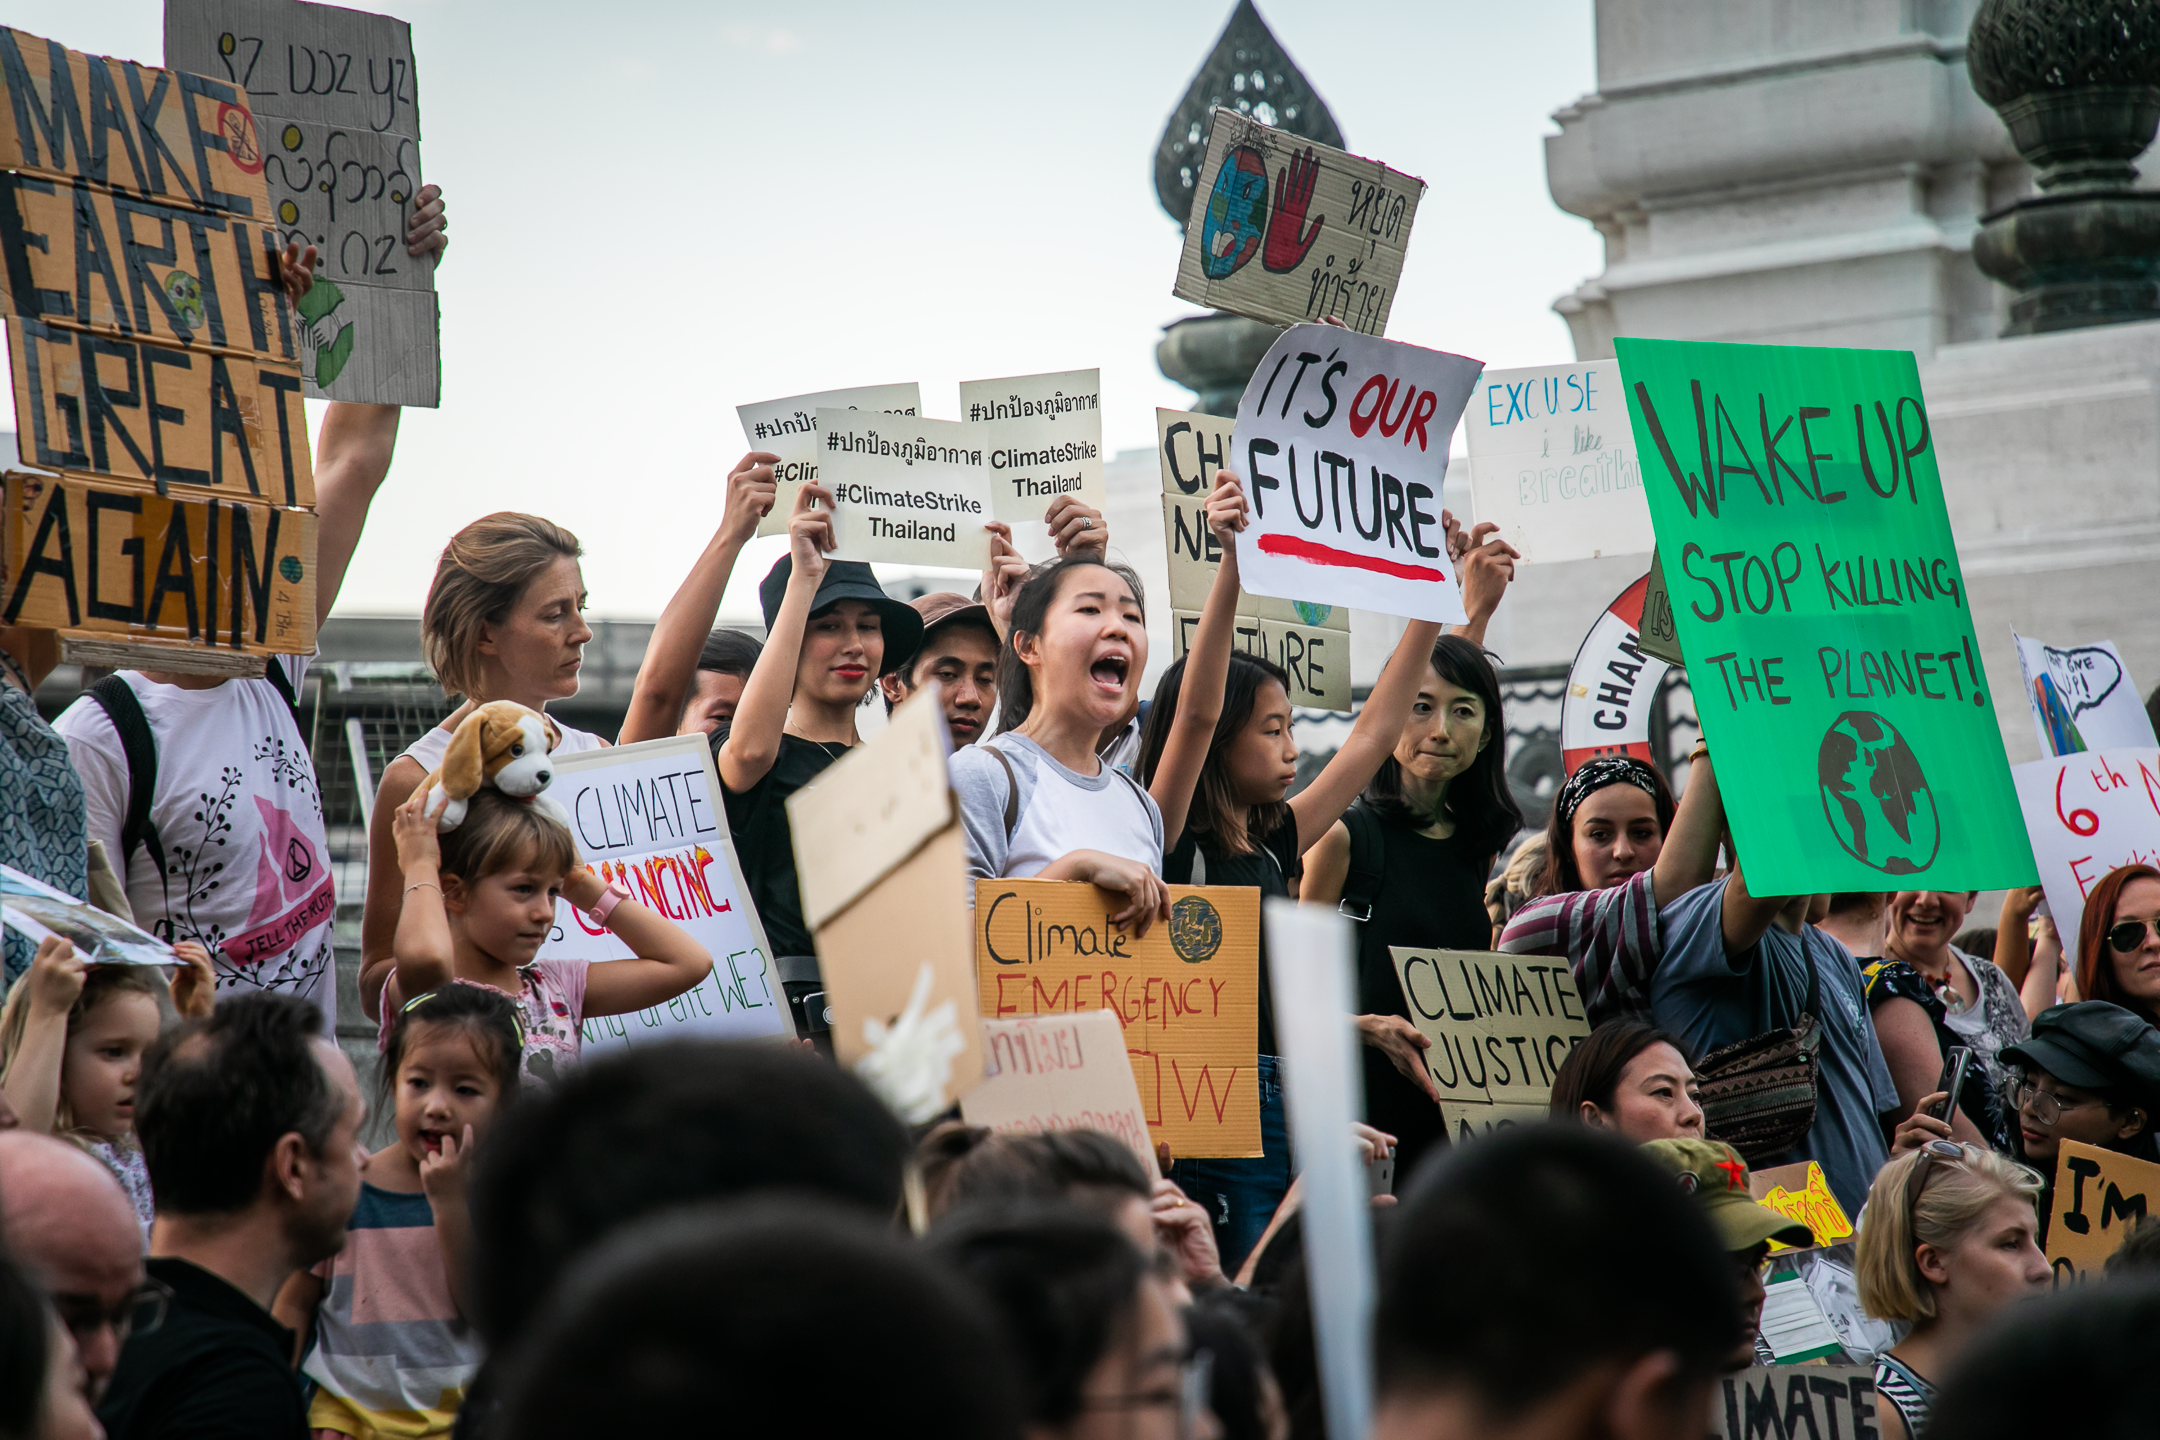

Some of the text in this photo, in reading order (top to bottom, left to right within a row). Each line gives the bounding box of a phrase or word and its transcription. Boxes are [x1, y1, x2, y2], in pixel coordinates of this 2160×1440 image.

[0, 27, 252, 216] MAKE
[0, 168, 299, 360] EARTH
[22, 316, 301, 507] GREAT
[970, 391, 1098, 422] #ปกป้องภูมิอากาศ
[1257, 347, 1438, 453] IT'S OUR
[1488, 372, 1598, 426] EXCUSE
[827, 430, 982, 466] #ปกป้องภูมิอากาศ
[989, 441, 1097, 470] ClimateStrike
[1165, 421, 1232, 495] CH
[1519, 449, 1643, 506] Breathi
[1634, 379, 1929, 518] WAKE UP
[836, 483, 982, 514] #ClimateStrike
[1012, 472, 1082, 498] Thailand
[1248, 438, 1440, 559] FUTURE
[868, 516, 955, 542] Thailand
[3, 483, 281, 650] AGAIN
[1682, 541, 1960, 623] STOP KILLING
[1594, 632, 1648, 731] CHAN
[1705, 652, 1791, 711] THE
[1818, 636, 1984, 708] PLANET!
[576, 770, 716, 850] CLIMATE
[245, 929, 285, 956] TELL
[985, 892, 1132, 965] Climate
[711, 948, 773, 1014] WE?
[996, 971, 1226, 1029] EMERGENCY
[1404, 956, 1584, 1021] CLIMATE
[1433, 1032, 1586, 1089] JUSTIC
[2063, 1156, 2147, 1235] I'M
